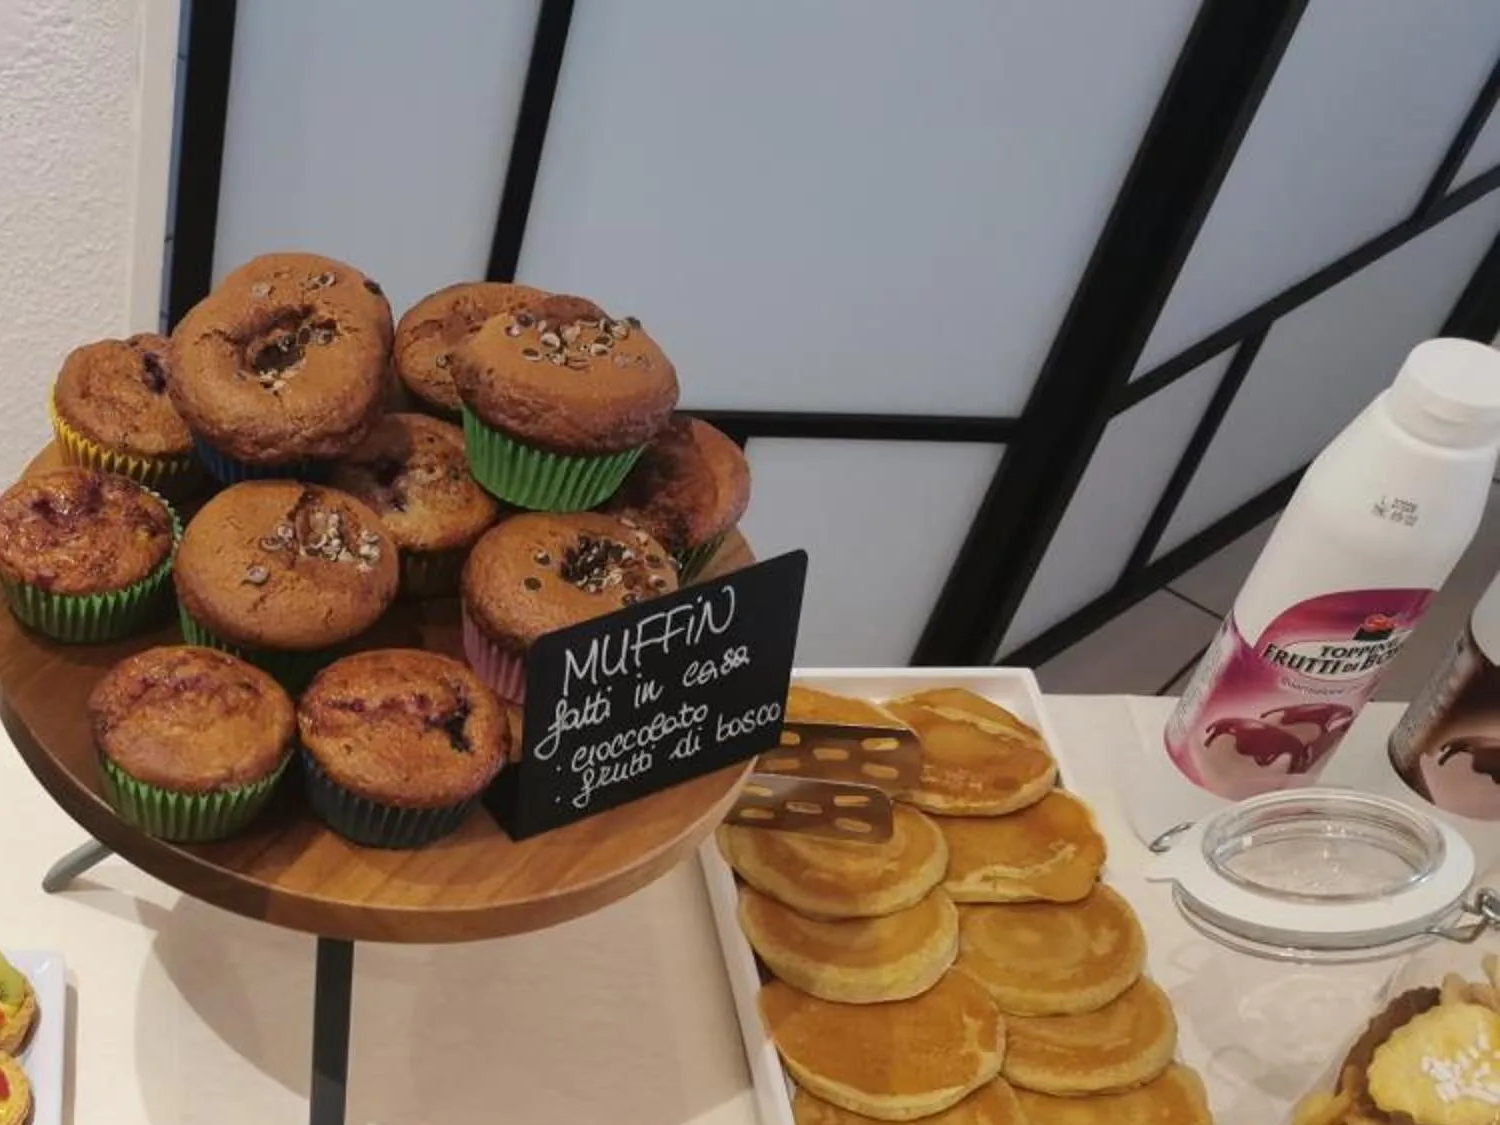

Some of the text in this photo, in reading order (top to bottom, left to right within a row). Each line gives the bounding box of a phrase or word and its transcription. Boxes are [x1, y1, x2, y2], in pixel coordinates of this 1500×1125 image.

[533, 644, 750, 761] fatti in casa
[1261, 642, 1341, 675] FRUTTI
[570, 702, 710, 773] cioccolato
[572, 701, 782, 809] frutti di bosco
